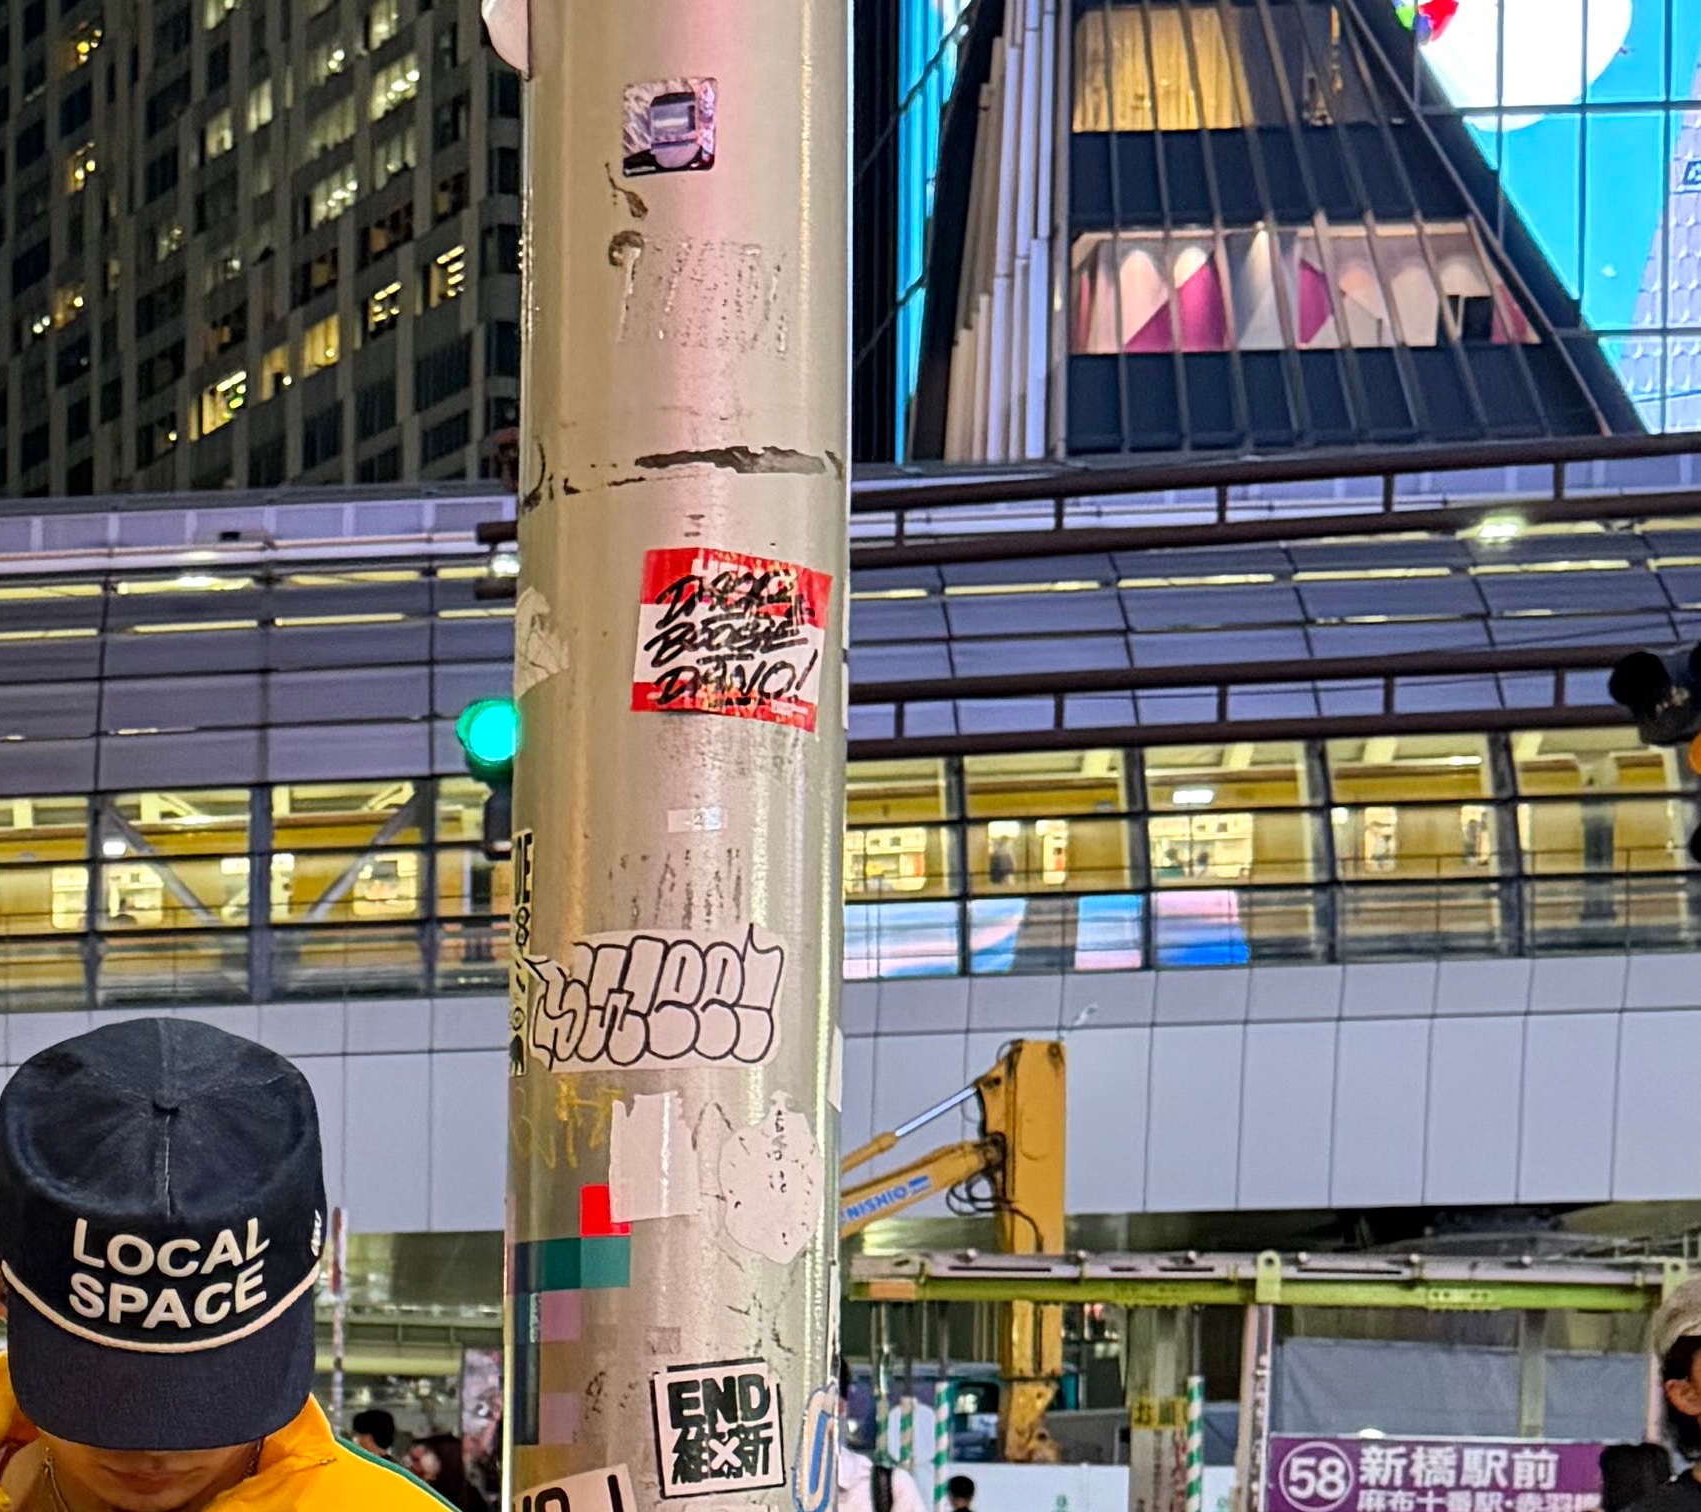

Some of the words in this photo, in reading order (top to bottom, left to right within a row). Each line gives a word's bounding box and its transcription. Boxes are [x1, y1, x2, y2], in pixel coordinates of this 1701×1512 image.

[73, 1216, 270, 1278] LOCAL
[69, 1258, 268, 1329] SPACE
[667, 1373, 772, 1430] END
[1287, 1457, 1346, 1500] 58
[1358, 1445, 1559, 1490] 新橋駅前
